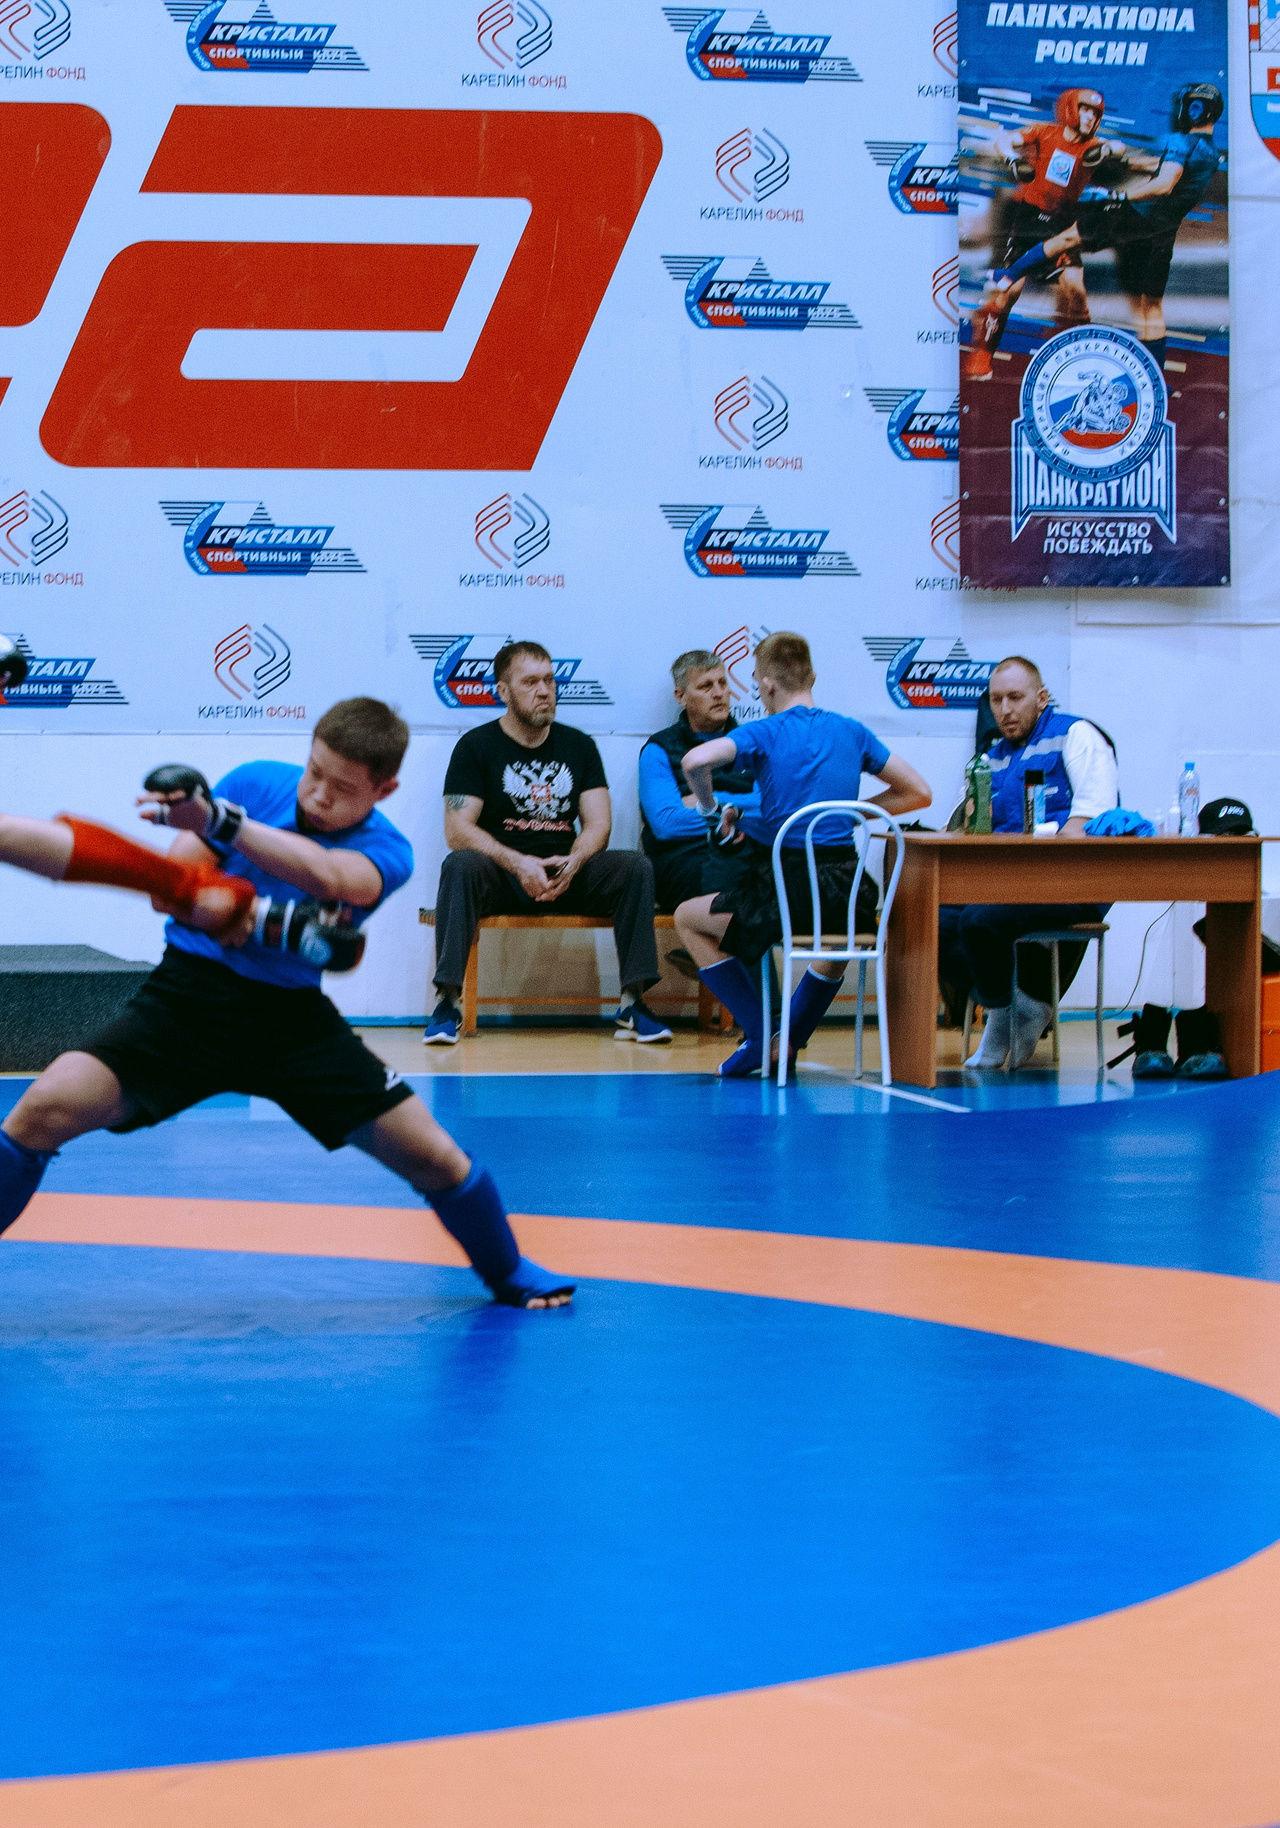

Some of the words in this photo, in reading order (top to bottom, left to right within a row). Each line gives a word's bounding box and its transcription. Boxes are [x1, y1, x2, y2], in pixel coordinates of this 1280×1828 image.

[985, 2, 1195, 32] ПАНКРАТИОНА
[208, 24, 331, 41] КРИСТАЛЛ
[708, 34, 823, 52] КРИСТАЛЛ
[208, 48, 303, 59] СПОРТИВНЫЙ
[1035, 39, 1149, 66] РОССИИ
[708, 57, 800, 69] СПОРТИВНЫЙ
[47, 67, 86, 80] ФОНД
[461, 73, 526, 87] КАРЕЛИН
[528, 75, 567, 89] ФОНД
[917, 85, 958, 98] КАРЕЛ
[699, 207, 764, 221] КАРЕЛИН
[766, 208, 804, 223] ФОНД
[706, 283, 821, 300] КРИСТАЛЛ
[706, 305, 799, 318] СПОРТИВНЫЙ
[916, 330, 959, 344] КАРЕЛ
[698, 456, 762, 470] КАРЕЛИН
[764, 457, 803, 471] ФОНД
[1020, 441, 1167, 513] ПАНКРАТИОН
[206, 528, 327, 544] КРИСТАЛЛ
[1046, 521, 1152, 538] ИСКУССТВО
[704, 530, 822, 547] КРИСТАЛЛ
[1042, 538, 1153, 556] ПОБЕЖДАТЬ
[206, 551, 302, 562] СПОРТИВНЫЙ
[705, 554, 798, 566] СПОРТИВНЫЙ
[43, 573, 84, 588] ФОНД
[459, 573, 523, 587] КАРЕЛИН
[525, 574, 564, 589] ФОНД
[28, 661, 89, 676] ТАЛЛ
[907, 663, 991, 679] КРИСТА
[198, 705, 263, 719] КАРЕЛИН
[266, 705, 306, 720] ФОНД
